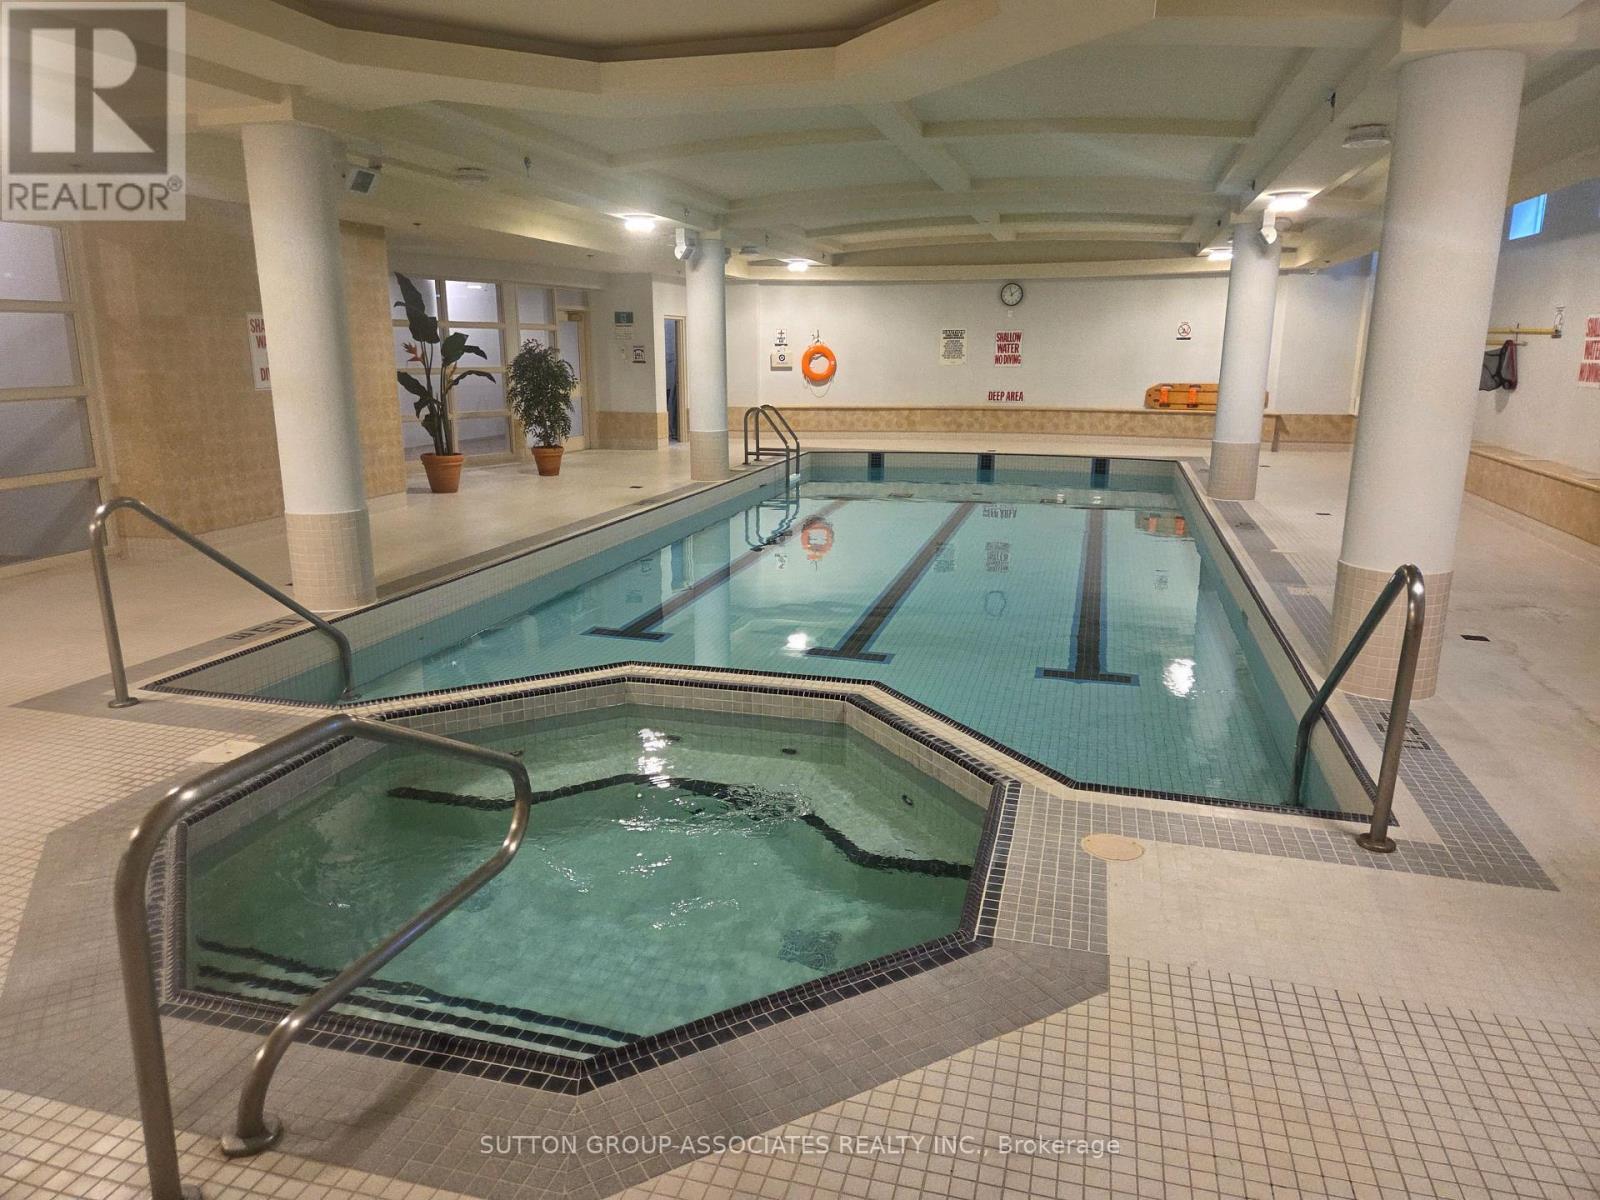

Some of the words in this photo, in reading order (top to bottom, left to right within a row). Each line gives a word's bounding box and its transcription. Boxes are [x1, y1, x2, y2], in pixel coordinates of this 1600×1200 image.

[996, 332, 1022, 343] SHALLOW
[997, 343, 1020, 353] WATER
[988, 391, 1005, 401] DEEP
[1006, 391, 1024, 402] AREA
